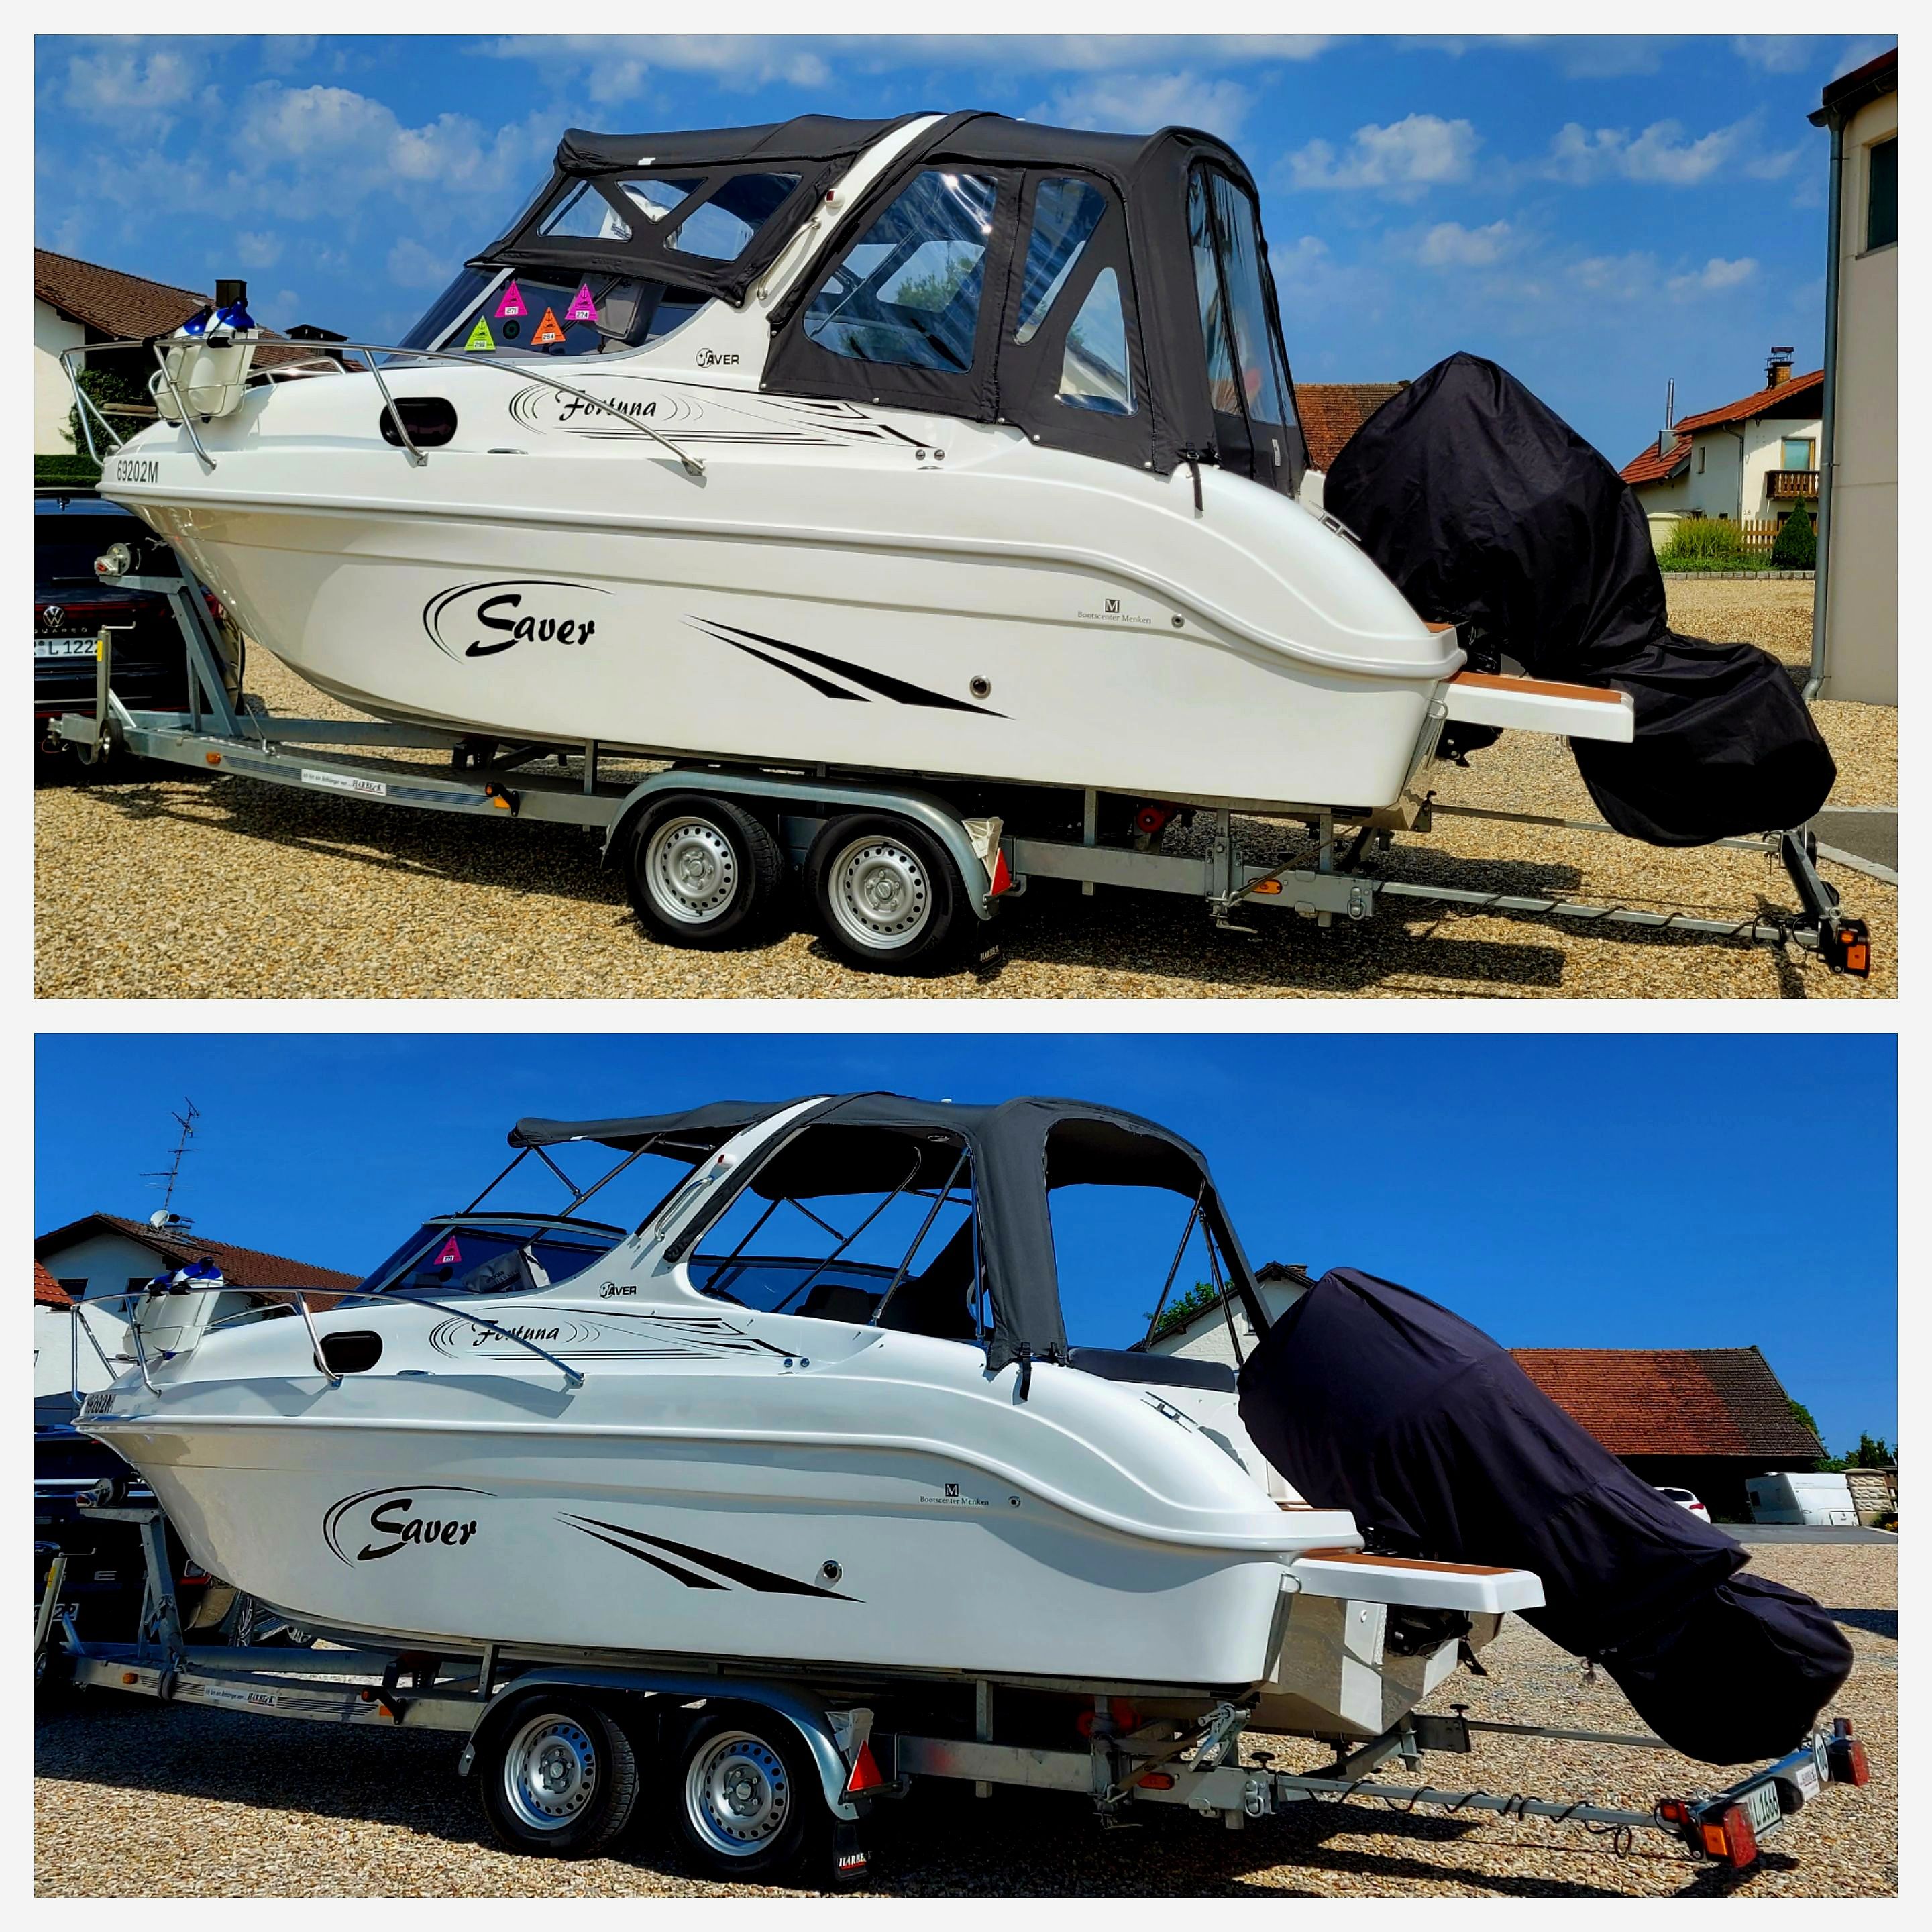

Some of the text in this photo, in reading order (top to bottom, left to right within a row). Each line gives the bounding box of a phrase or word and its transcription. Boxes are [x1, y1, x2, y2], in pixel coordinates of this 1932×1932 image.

[117, 460, 159, 483] 69202M
[1105, 599, 1120, 613] M
[466, 594, 594, 657] Saver
[945, 1483, 959, 1497] M
[357, 1498, 478, 1560] Saver
[839, 1851, 872, 1867] HARBE
